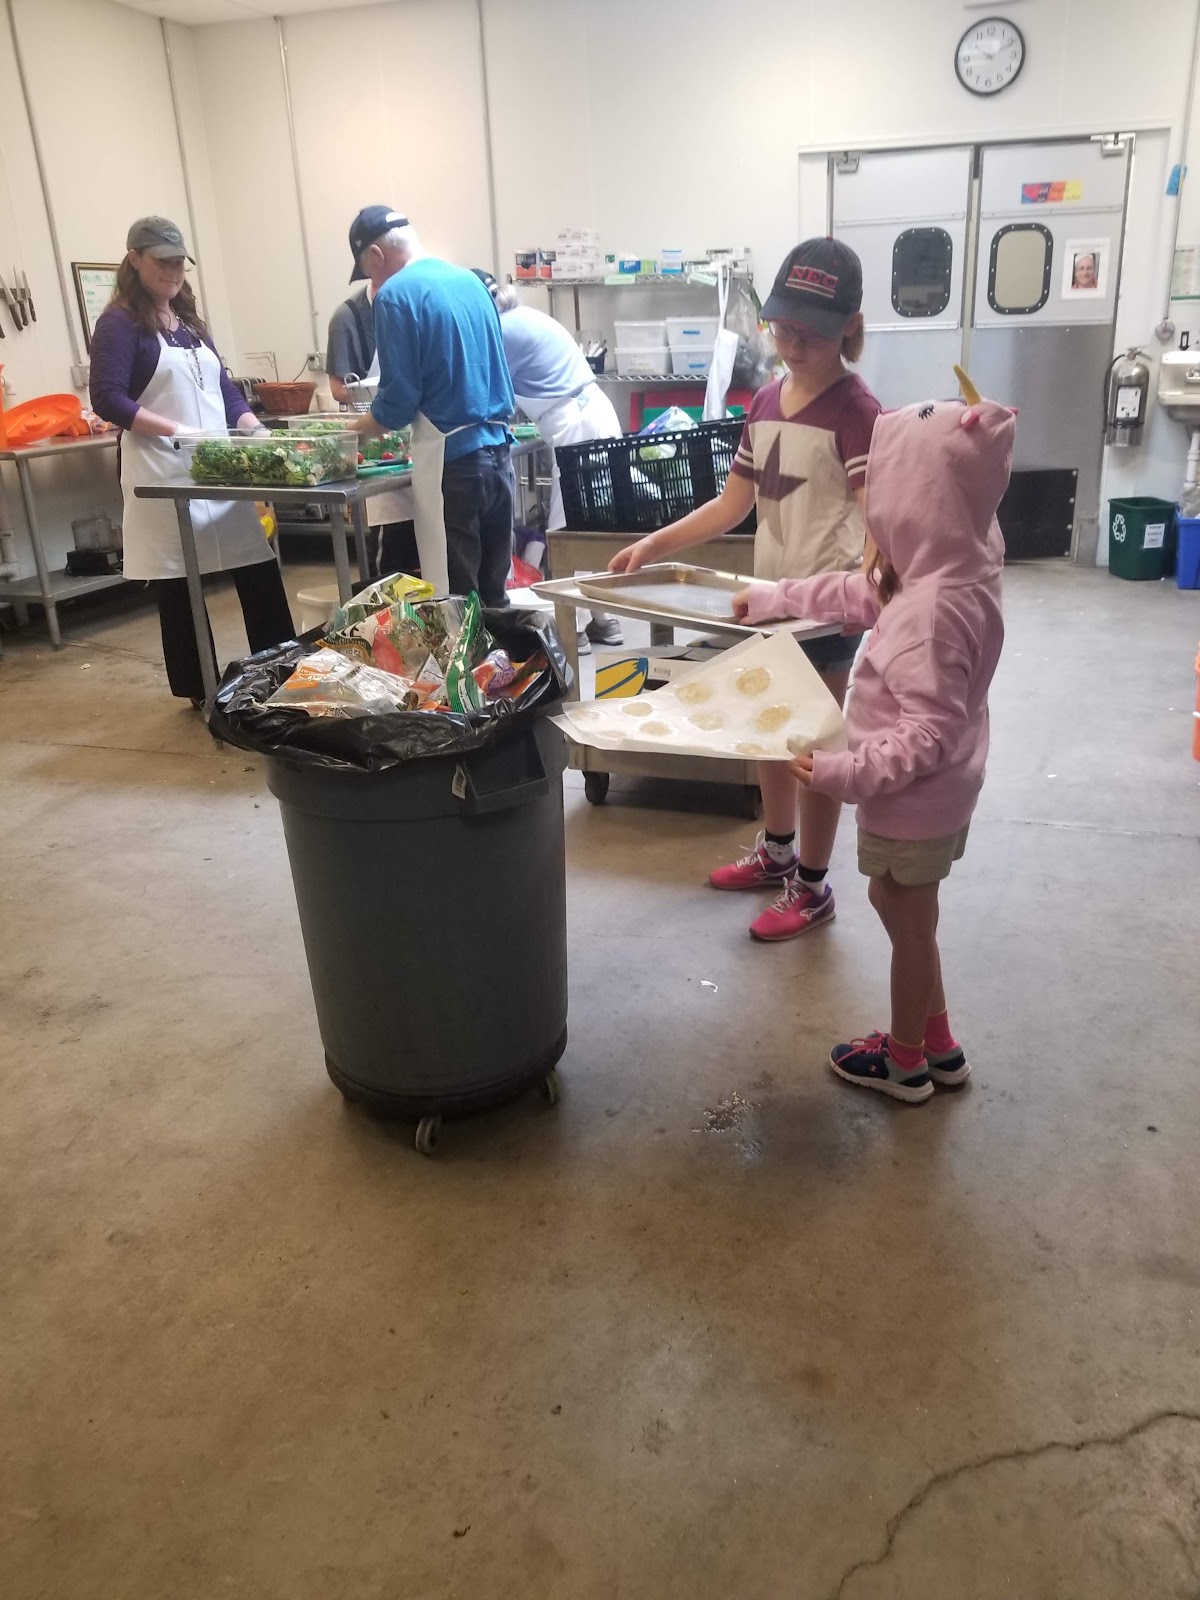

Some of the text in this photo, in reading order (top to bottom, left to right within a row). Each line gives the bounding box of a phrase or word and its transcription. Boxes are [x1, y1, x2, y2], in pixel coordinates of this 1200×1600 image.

[987, 24, 996, 36] 12
[976, 31, 983, 41] 11
[963, 55, 971, 63] 9
[1011, 50, 1017, 60] 3
[966, 67, 973, 77] 8
[1006, 64, 1012, 72] 4
[975, 75, 981, 85] 7
[996, 73, 1003, 83] 5
[984, 79, 992, 88] 6
